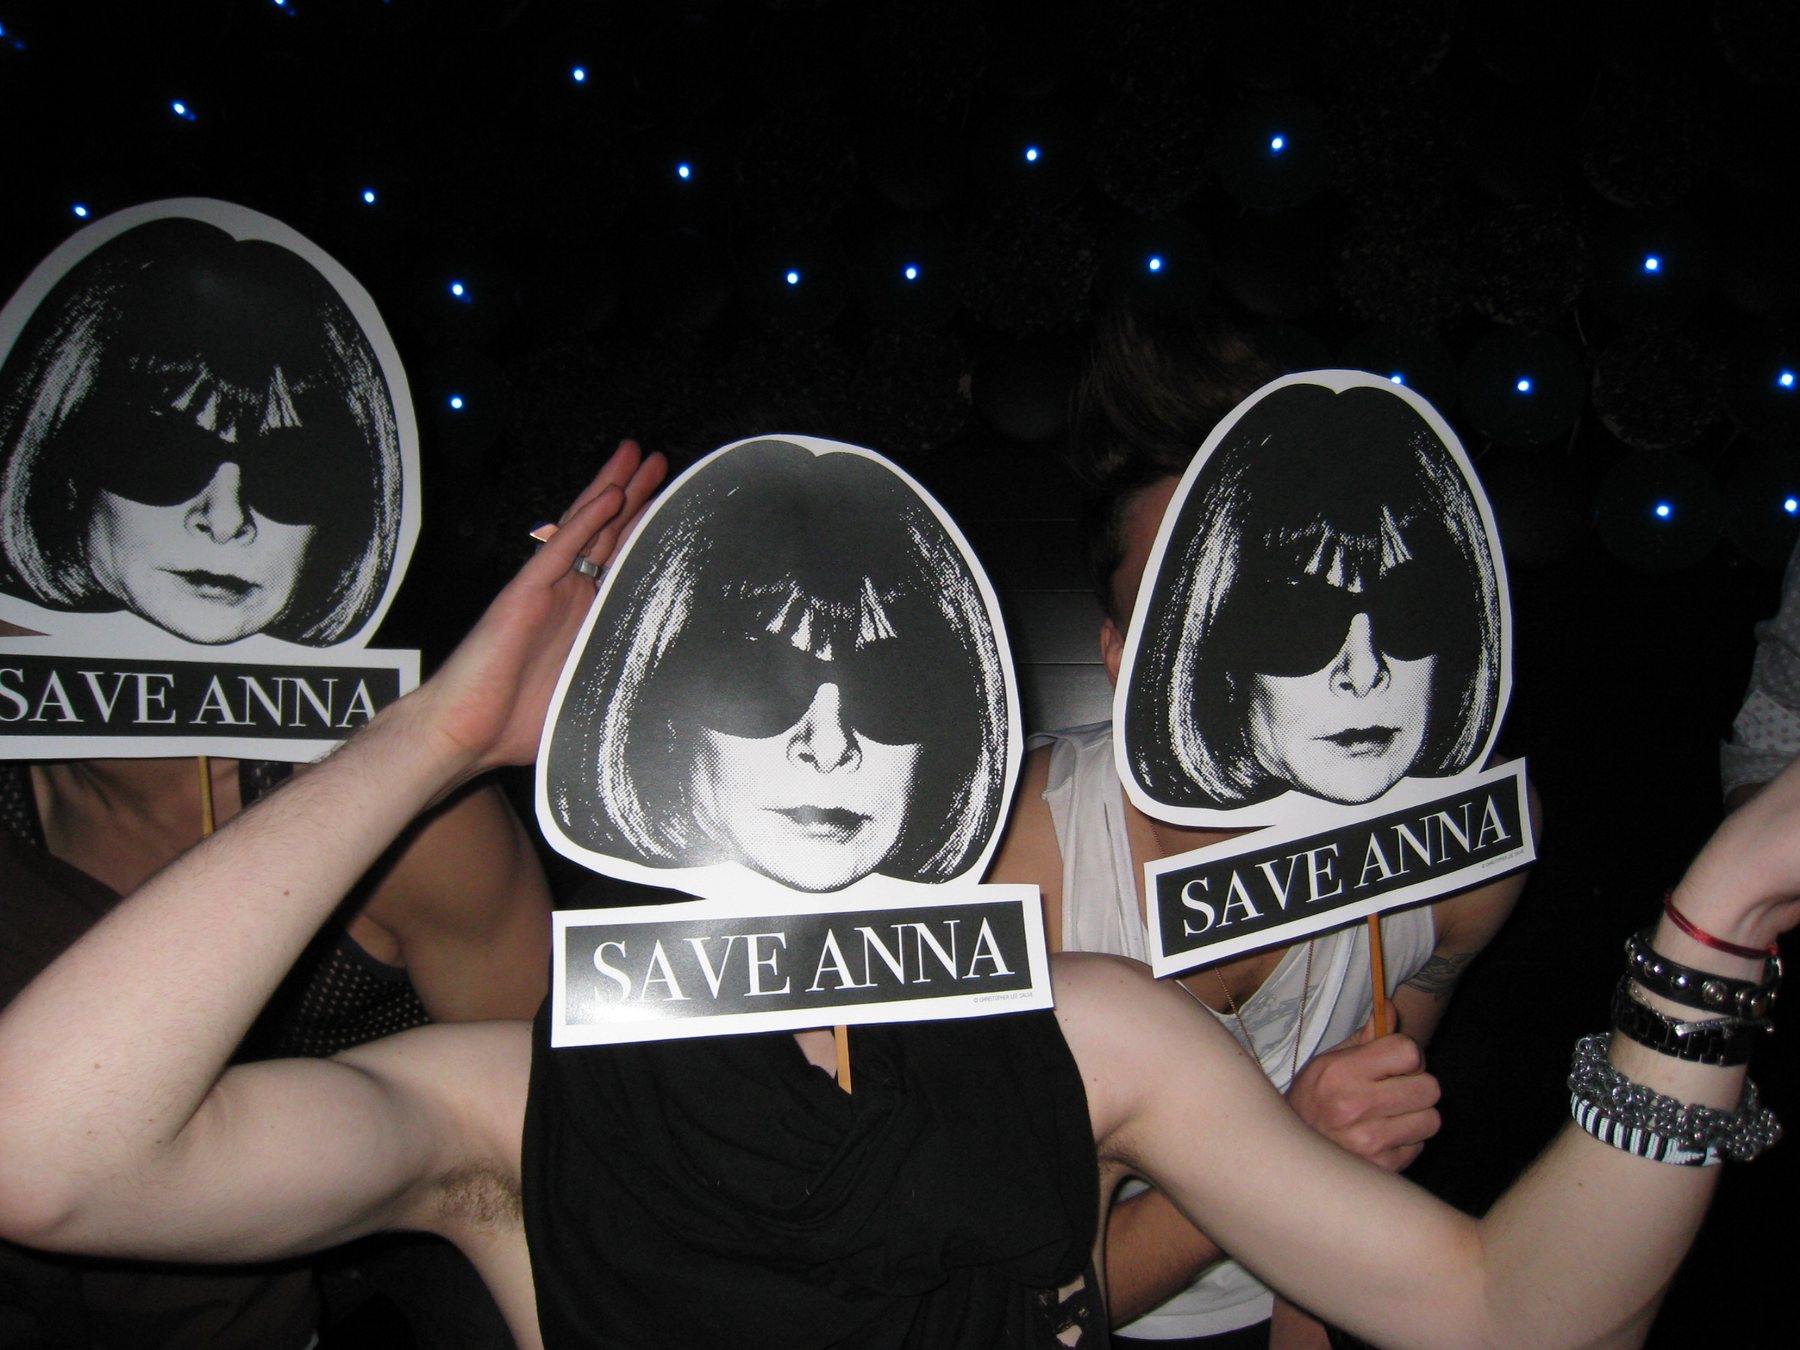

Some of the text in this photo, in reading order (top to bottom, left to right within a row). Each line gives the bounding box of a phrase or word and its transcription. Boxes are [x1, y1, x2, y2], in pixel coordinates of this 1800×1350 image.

[0, 668, 376, 728] SAVE ANNA
[1181, 795, 1511, 937] SAVE ANNA
[593, 917, 1015, 1005] SAVE ANNA
